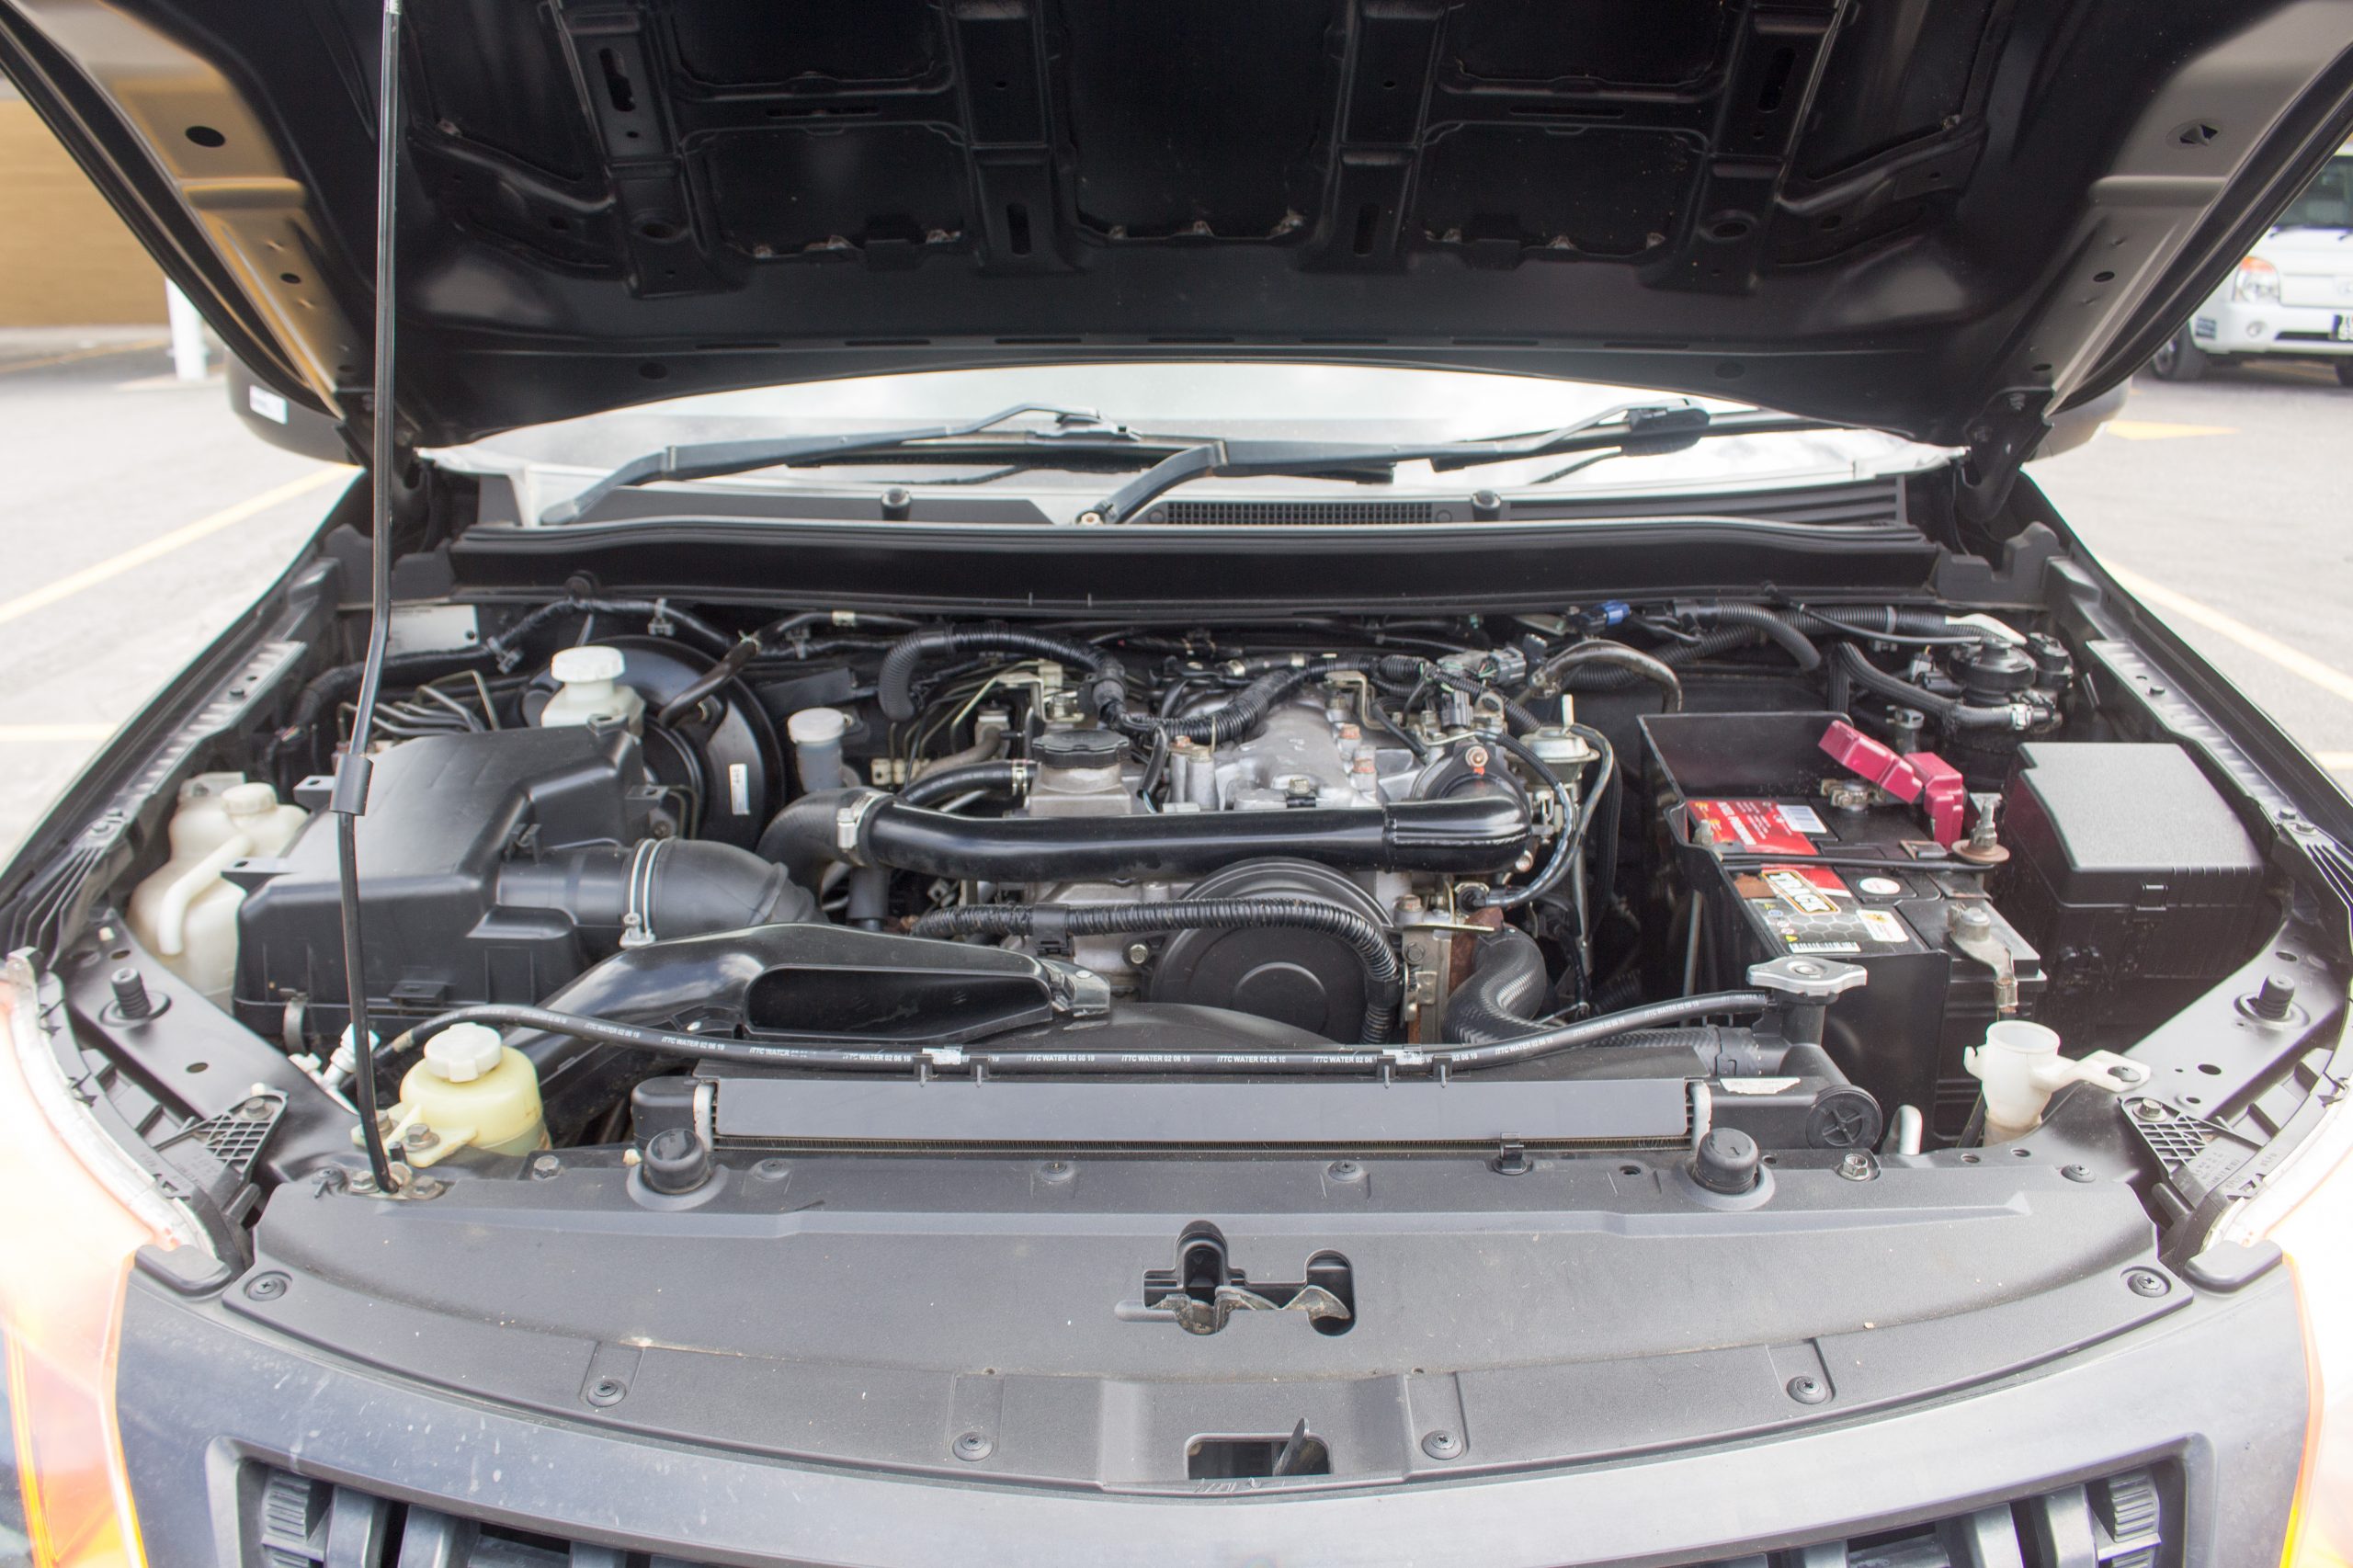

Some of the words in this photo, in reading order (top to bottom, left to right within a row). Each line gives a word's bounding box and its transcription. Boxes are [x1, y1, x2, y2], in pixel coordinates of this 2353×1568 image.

[1768, 872, 1832, 913] TRACK
[676, 1038, 699, 1048] WATER
[1508, 1041, 1530, 1052] WATER
[859, 1052, 883, 1061] WATER
[1042, 1053, 1067, 1062] WATER
[1138, 1054, 1163, 1062] WATER
[1164, 1054, 1172, 1062] 02
[1233, 1055, 1258, 1063] WATER
